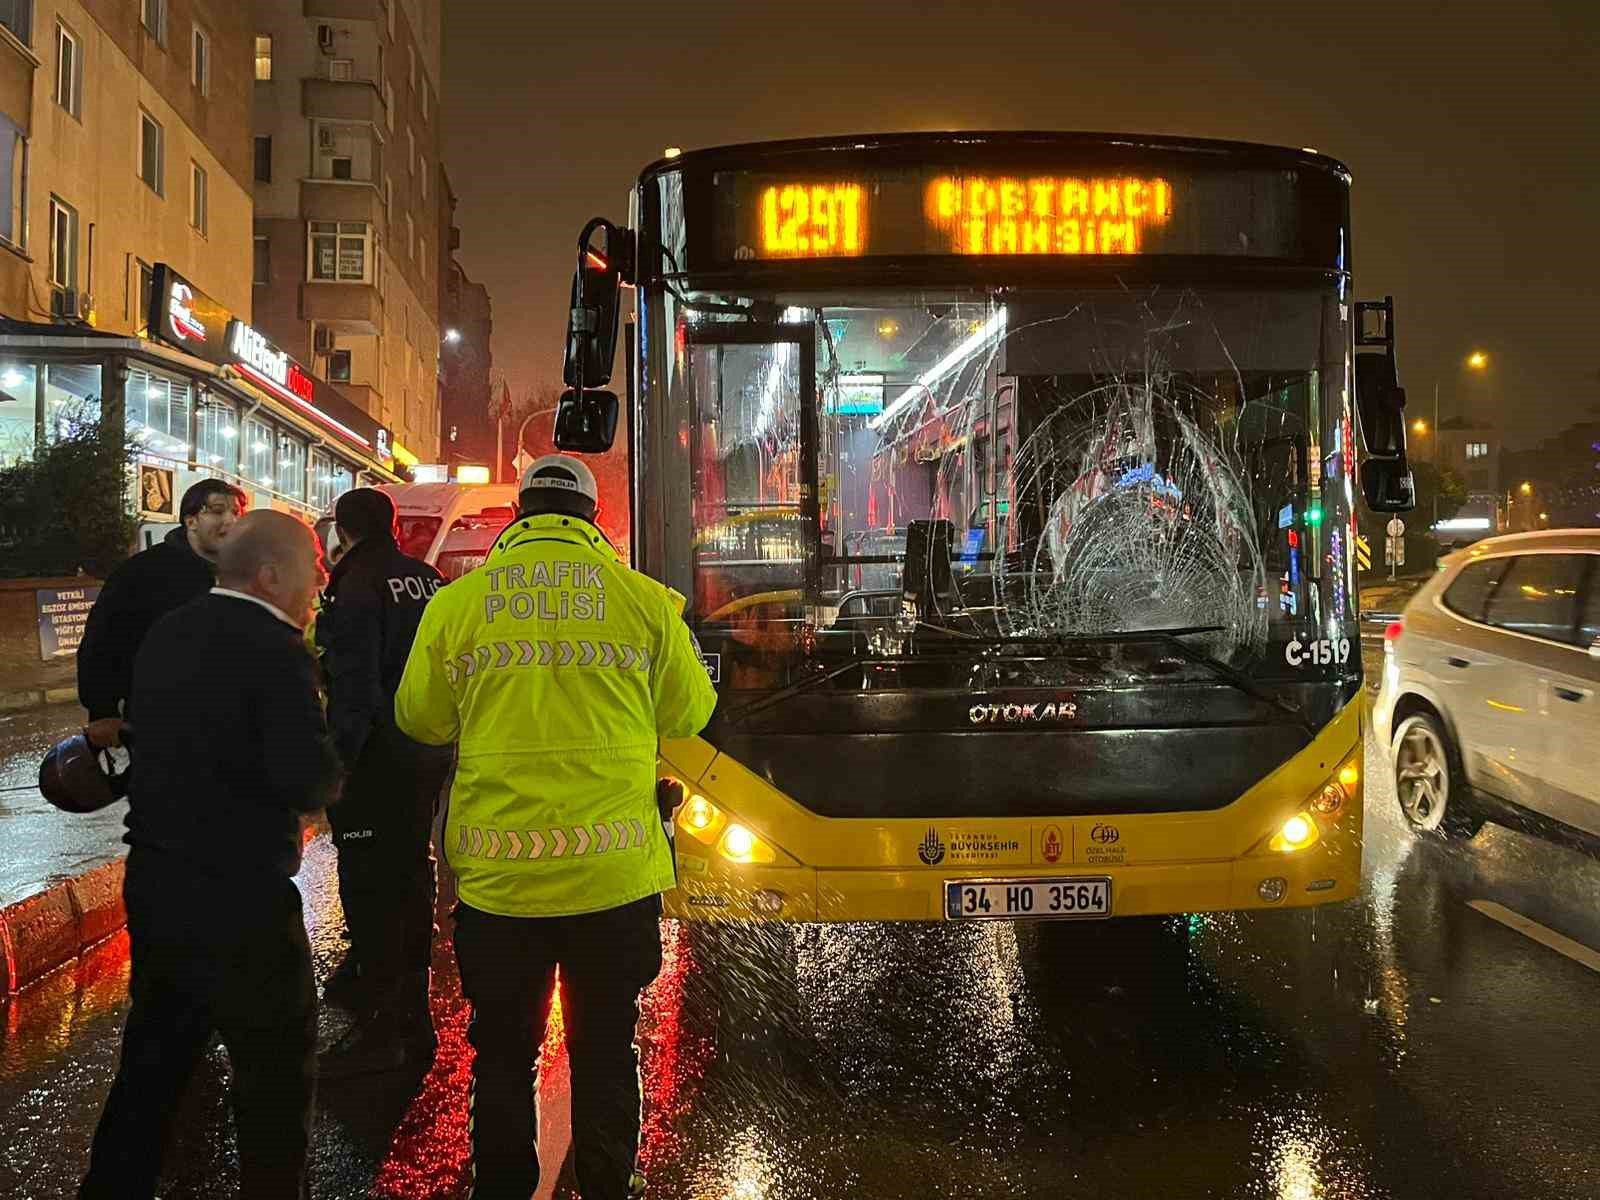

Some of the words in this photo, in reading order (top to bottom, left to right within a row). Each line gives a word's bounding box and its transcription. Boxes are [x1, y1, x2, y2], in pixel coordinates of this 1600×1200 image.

[1285, 639, 1350, 666] C-1519
[969, 702, 1077, 722] OTOKAR
[964, 888, 991, 913] 34
[1049, 886, 1103, 911] 3564
